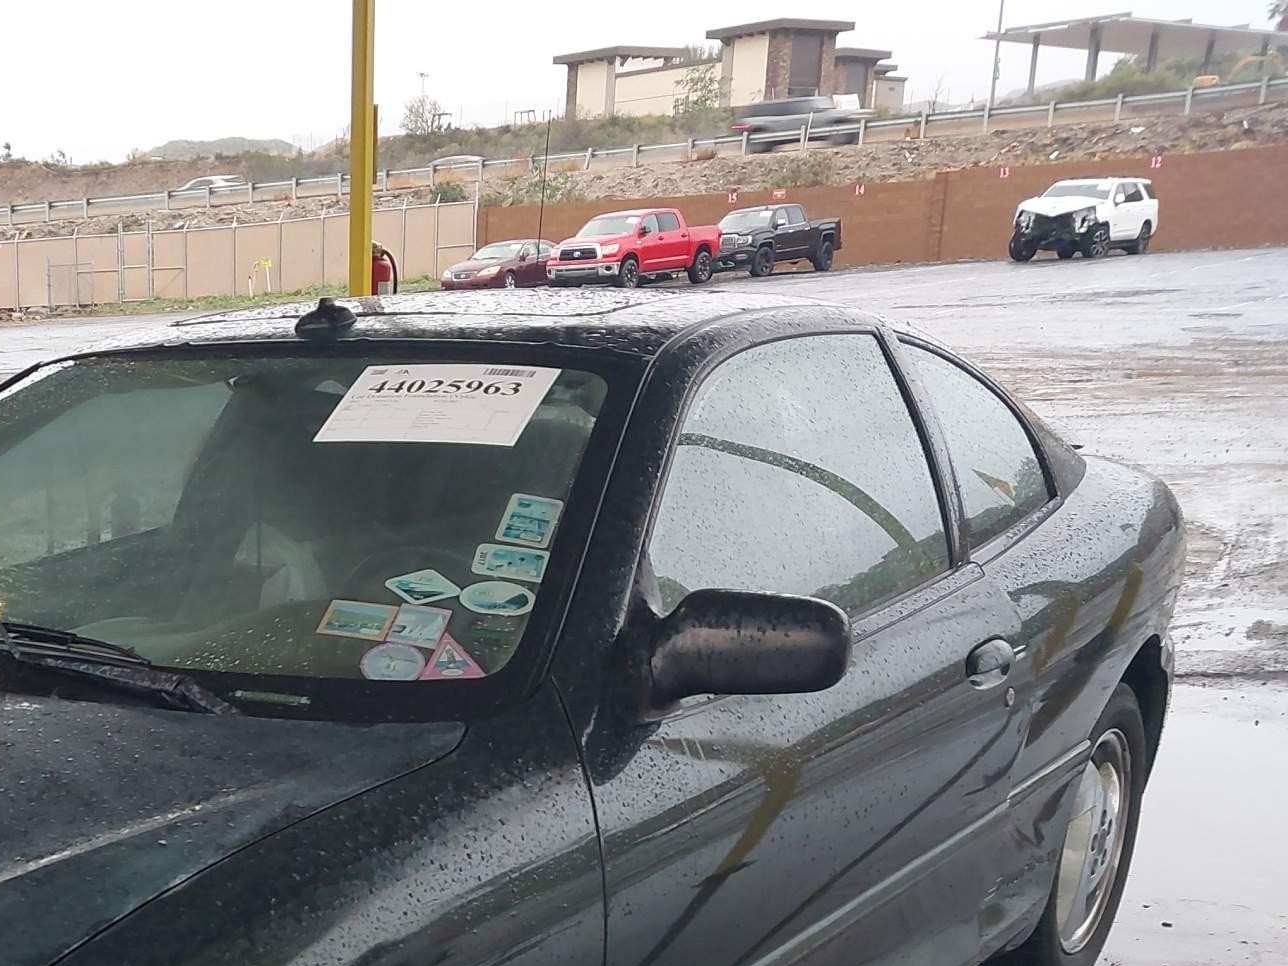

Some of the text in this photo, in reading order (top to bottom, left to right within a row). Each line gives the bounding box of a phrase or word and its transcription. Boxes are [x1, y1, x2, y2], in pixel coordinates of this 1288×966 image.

[1150, 156, 1162, 169] 12
[999, 167, 1010, 178] 13
[855, 184, 865, 195] 14
[728, 192, 738, 203] 15
[368, 379, 523, 396] 44025963
